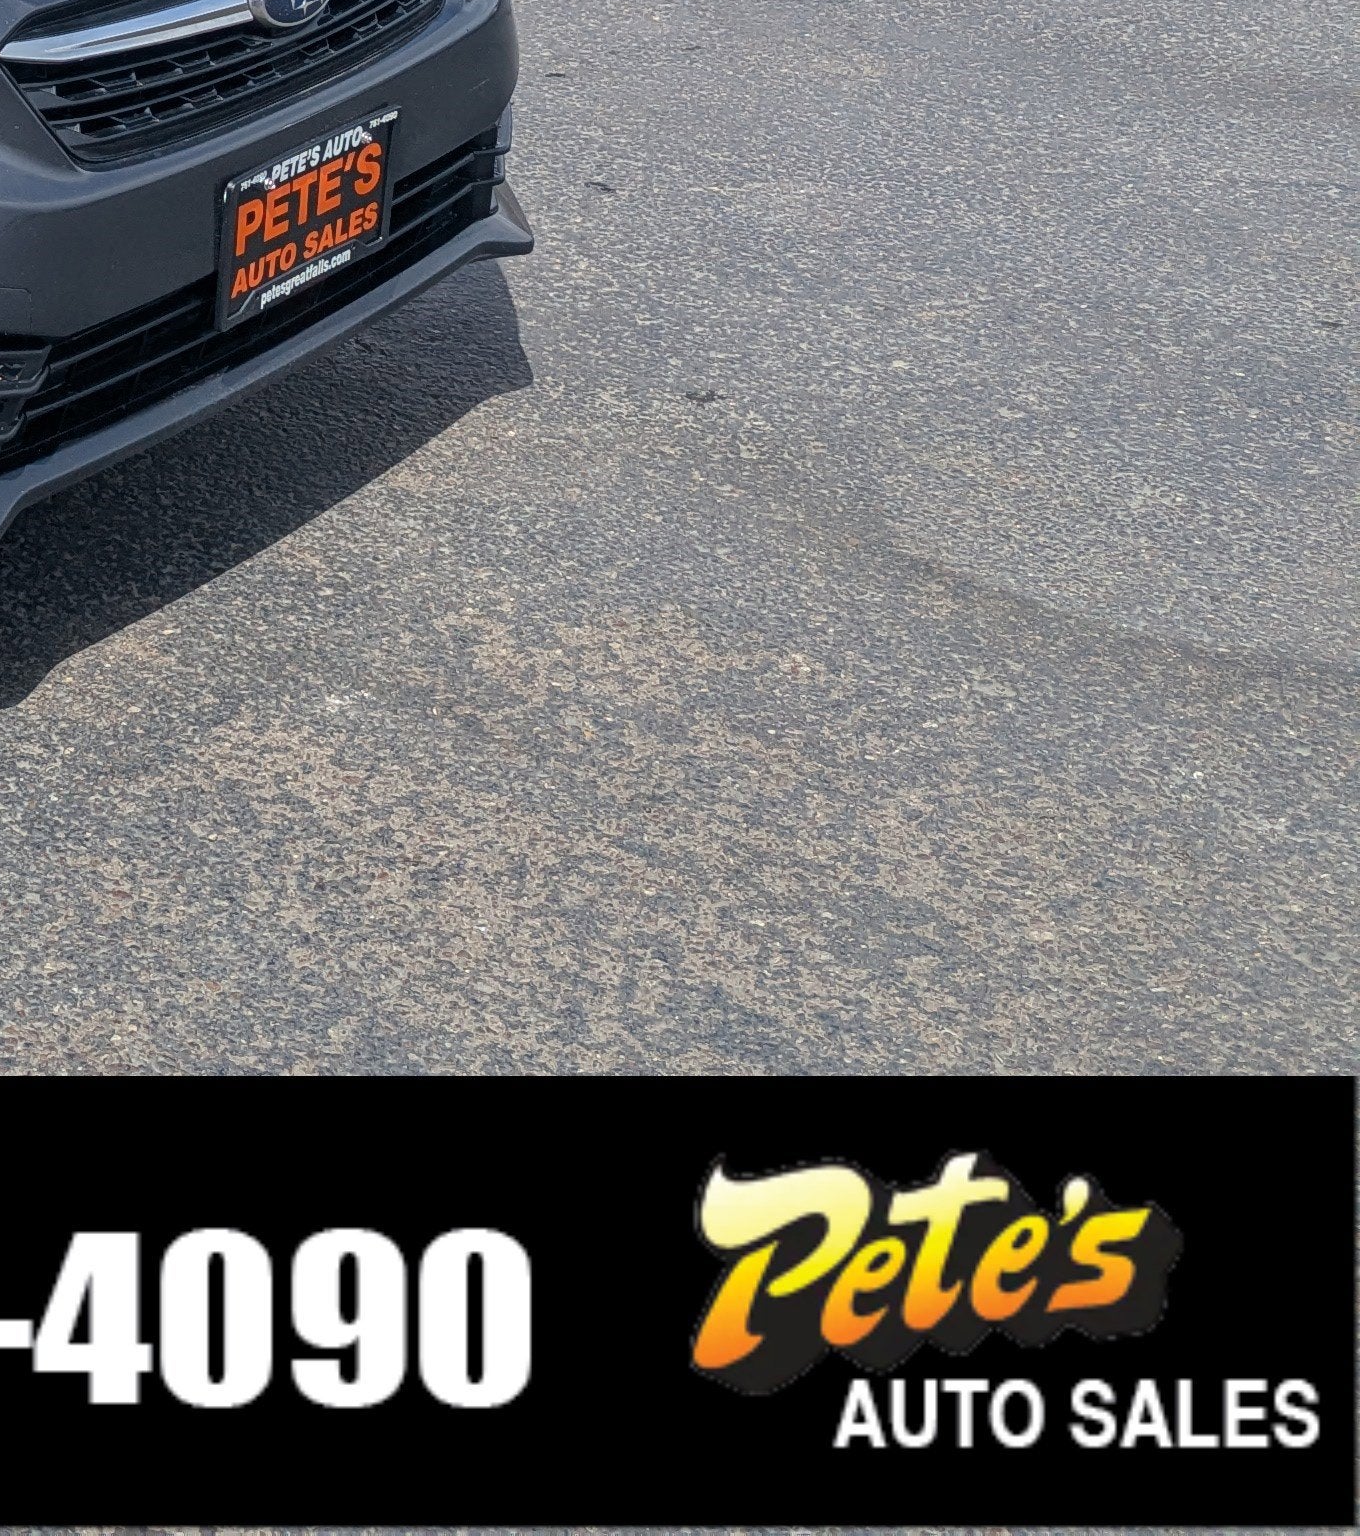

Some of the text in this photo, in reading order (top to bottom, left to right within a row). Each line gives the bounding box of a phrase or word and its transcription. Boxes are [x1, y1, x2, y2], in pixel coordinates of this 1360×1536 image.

[271, 125, 363, 183] PETE'S AUTO
[235, 142, 382, 257] PETE'S
[230, 201, 378, 299] AUTO SALES
[260, 248, 352, 310] petesgreatfalls.com
